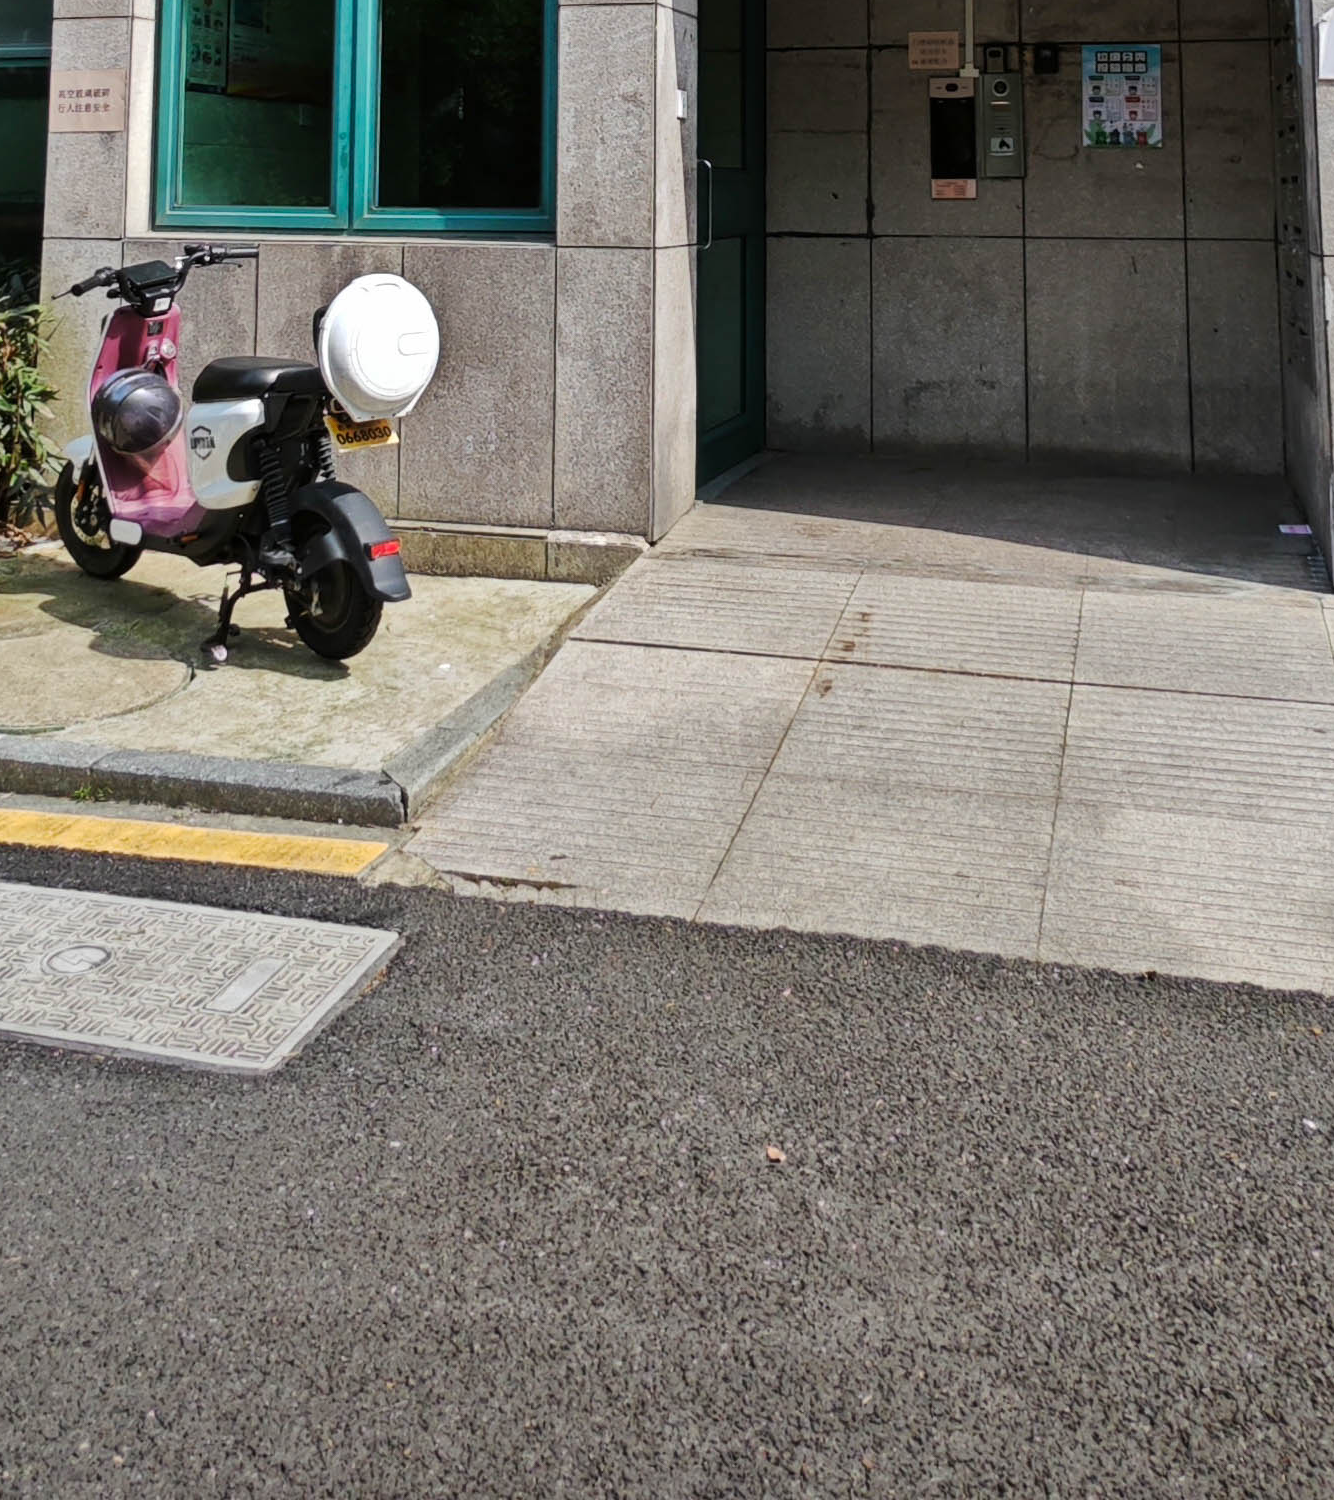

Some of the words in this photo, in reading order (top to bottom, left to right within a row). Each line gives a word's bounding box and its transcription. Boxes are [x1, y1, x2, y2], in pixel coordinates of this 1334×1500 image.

[58, 103, 111, 113] 行人注意安全
[336, 426, 392, 445] 0668030
